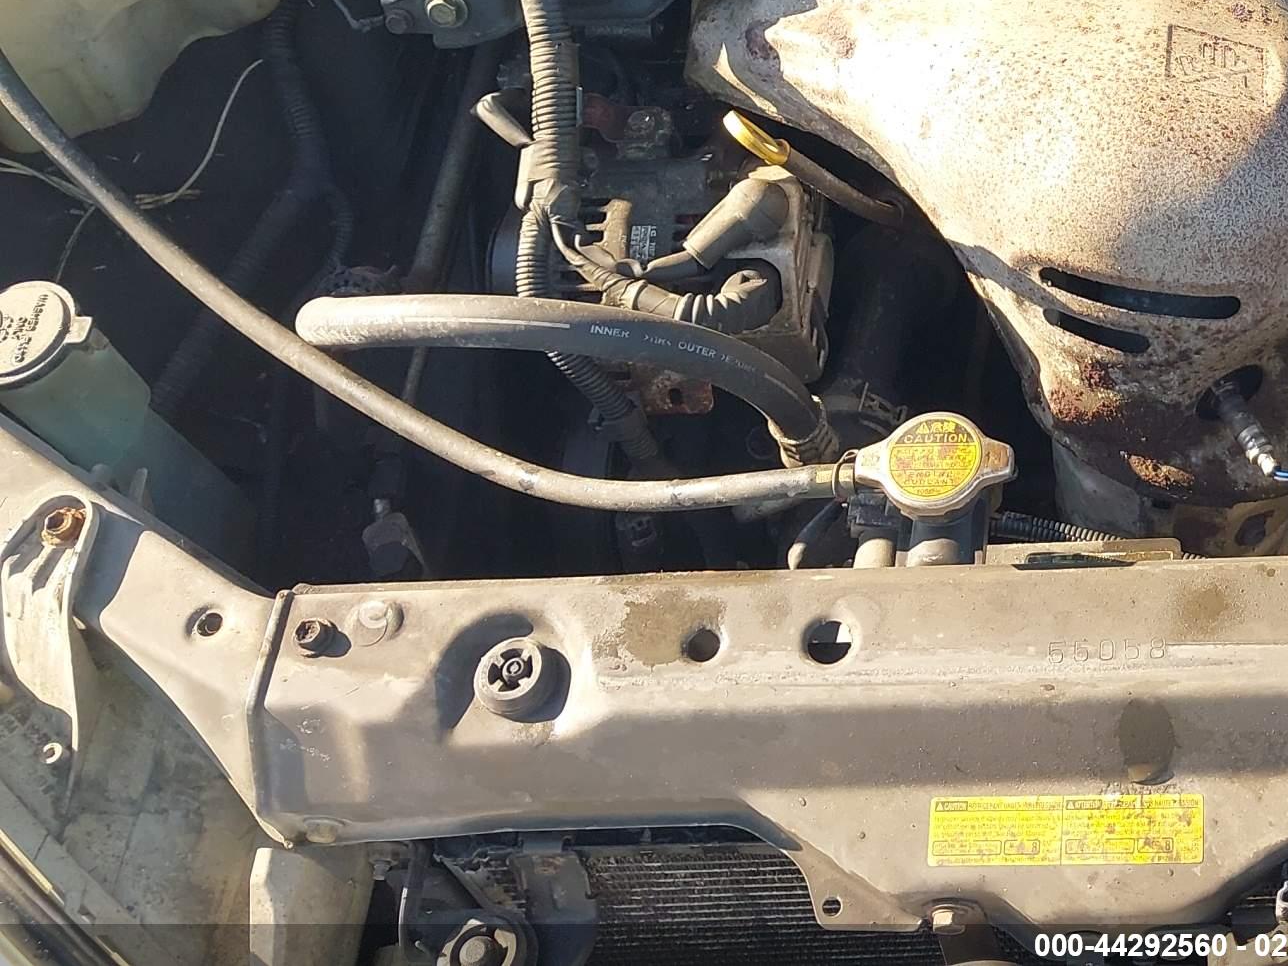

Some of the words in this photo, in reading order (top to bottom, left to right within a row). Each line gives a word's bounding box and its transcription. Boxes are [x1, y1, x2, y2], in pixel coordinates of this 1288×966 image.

[590, 324, 630, 338] INNER
[678, 341, 717, 359] OUTER
[904, 434, 968, 444] CAUTION
